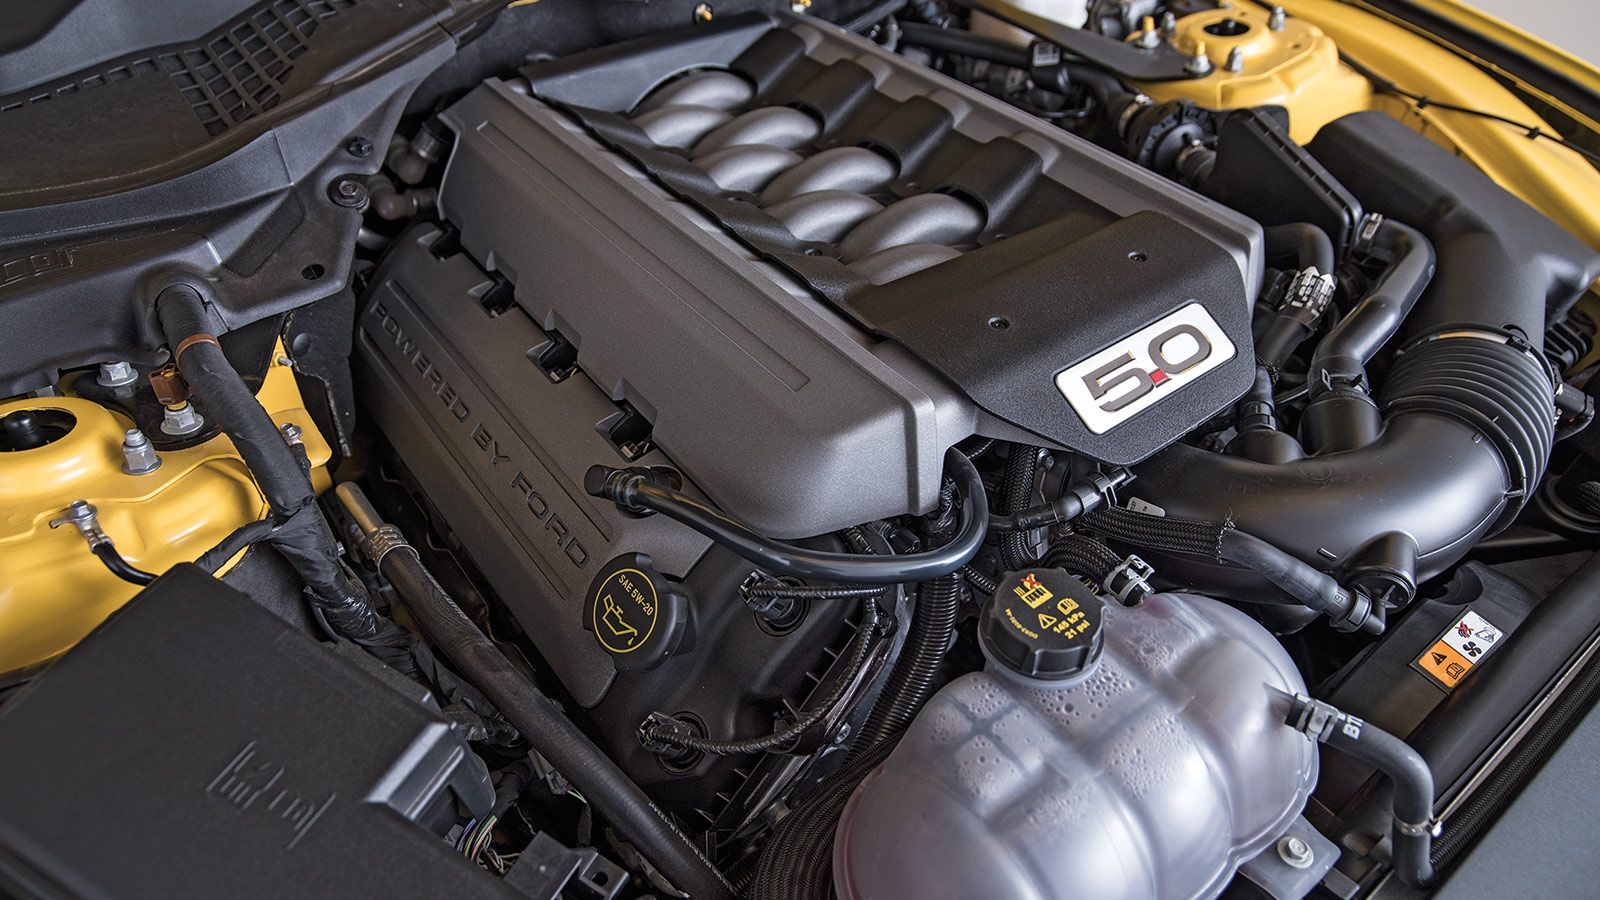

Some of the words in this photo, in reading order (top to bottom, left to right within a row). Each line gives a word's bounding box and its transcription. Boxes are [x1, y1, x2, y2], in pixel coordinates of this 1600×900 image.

[1081, 323, 1212, 412] 5.0
[369, 300, 470, 423] POWERED
[470, 422, 511, 465] BY
[510, 471, 589, 569] FORD
[618, 574, 634, 593] SAE
[631, 588, 654, 616] 5W-20
[1064, 628, 1077, 639] 21
[1076, 619, 1090, 633] psi
[1067, 611, 1085, 624] kPa
